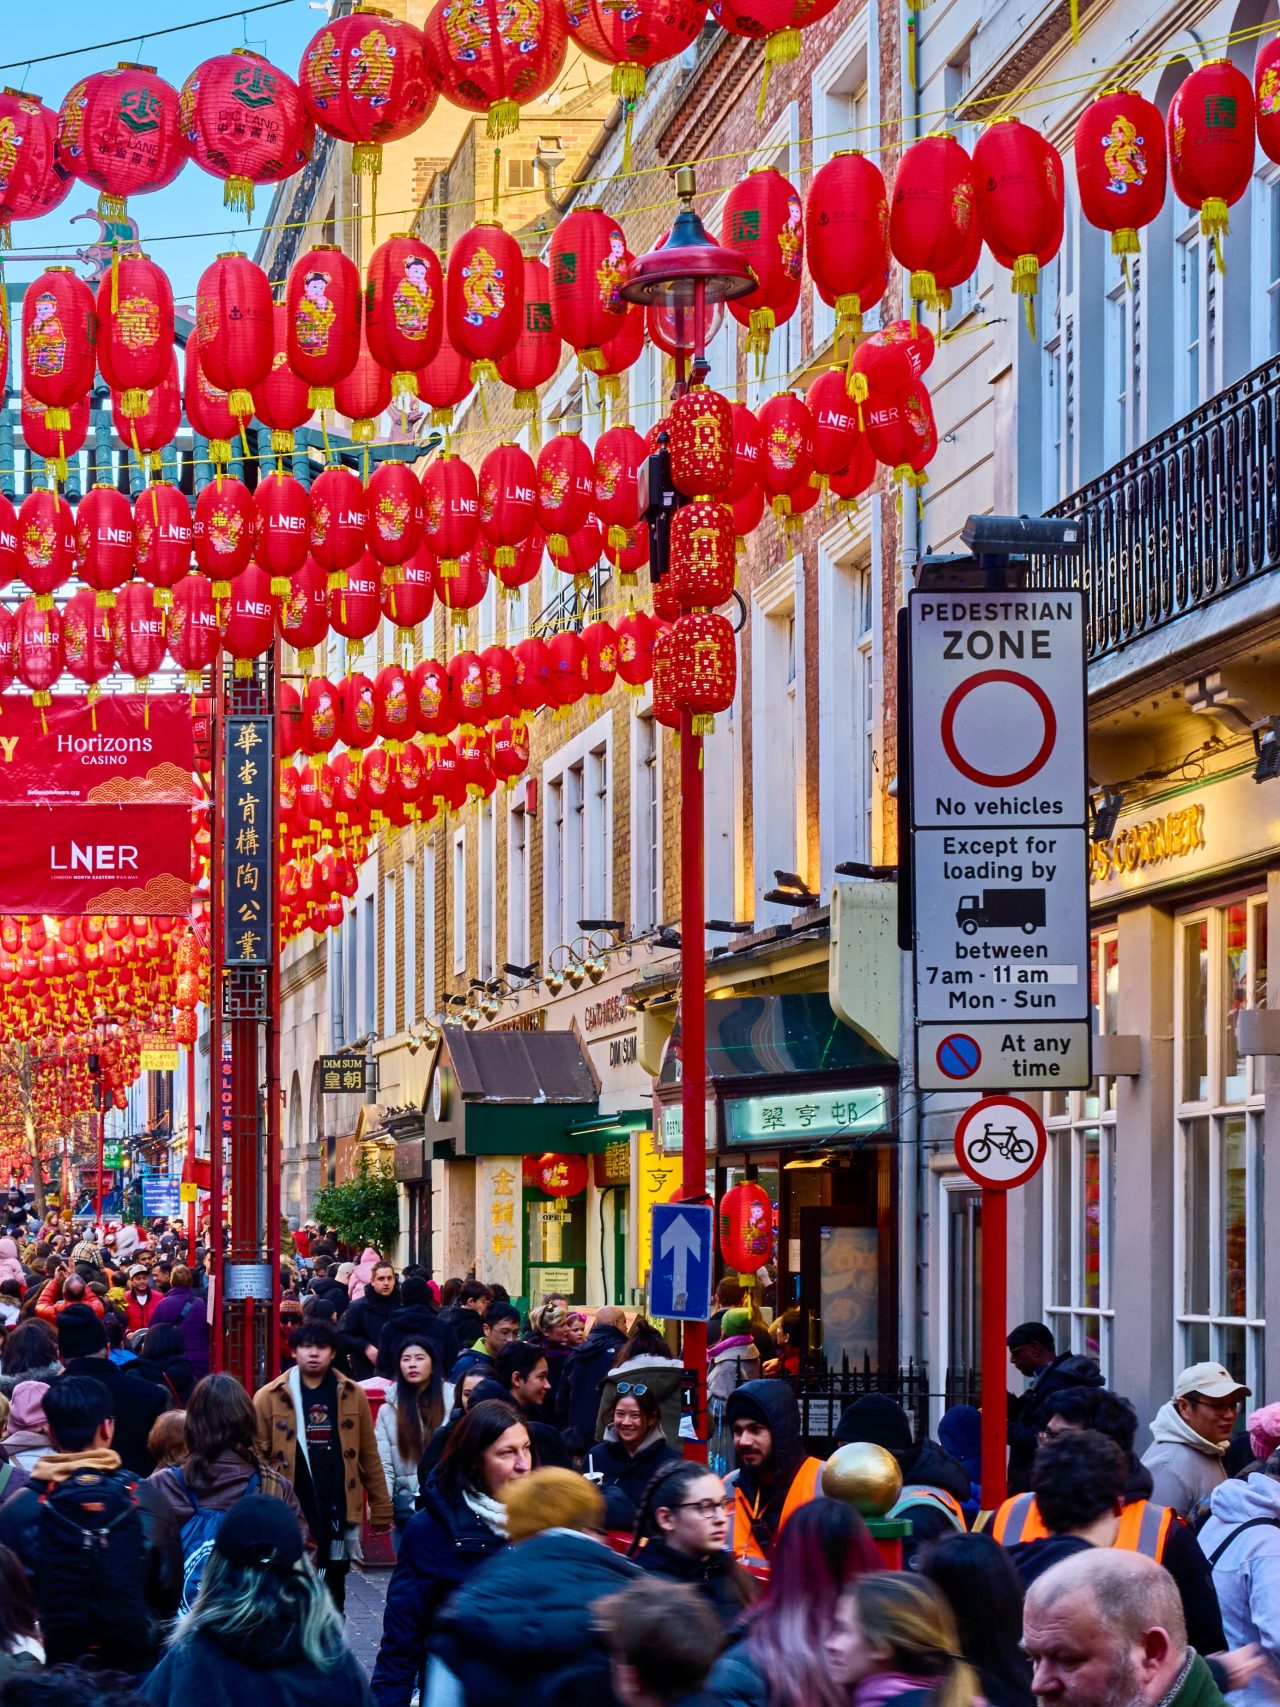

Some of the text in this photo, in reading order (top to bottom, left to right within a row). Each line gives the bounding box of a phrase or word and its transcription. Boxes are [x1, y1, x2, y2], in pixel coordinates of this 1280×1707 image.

[819, 409, 856, 430] LNER
[269, 513, 306, 530] LNER
[98, 527, 133, 544] LNER
[159, 525, 192, 541] LNER
[341, 579, 376, 593] LNER
[237, 599, 271, 616] LNER
[920, 602, 1073, 621] PEDESTRIAN
[24, 631, 59, 645] LNER
[943, 630, 1052, 660] ZONE
[56, 733, 153, 753] Horizons
[81, 755, 127, 765] CASINO
[936, 796, 1063, 816] No vehicles
[943, 836, 1057, 857] Except for
[1113, 804, 1200, 874] CORNER
[51, 840, 138, 874] LNER
[943, 861, 1057, 882] loading by
[955, 942, 1048, 959] between
[926, 966, 973, 984] 7am
[948, 991, 994, 1009] Mon
[1014, 990, 1057, 1008] Sun
[1000, 1034, 1072, 1055] At any
[323, 1059, 362, 1069] DIM SUM
[1012, 1059, 1060, 1077] time
[324, 1071, 362, 1089] 皇朝
[221, 1063, 233, 1131] SLOTS
[762, 1102, 858, 1130] 翠亨邨
